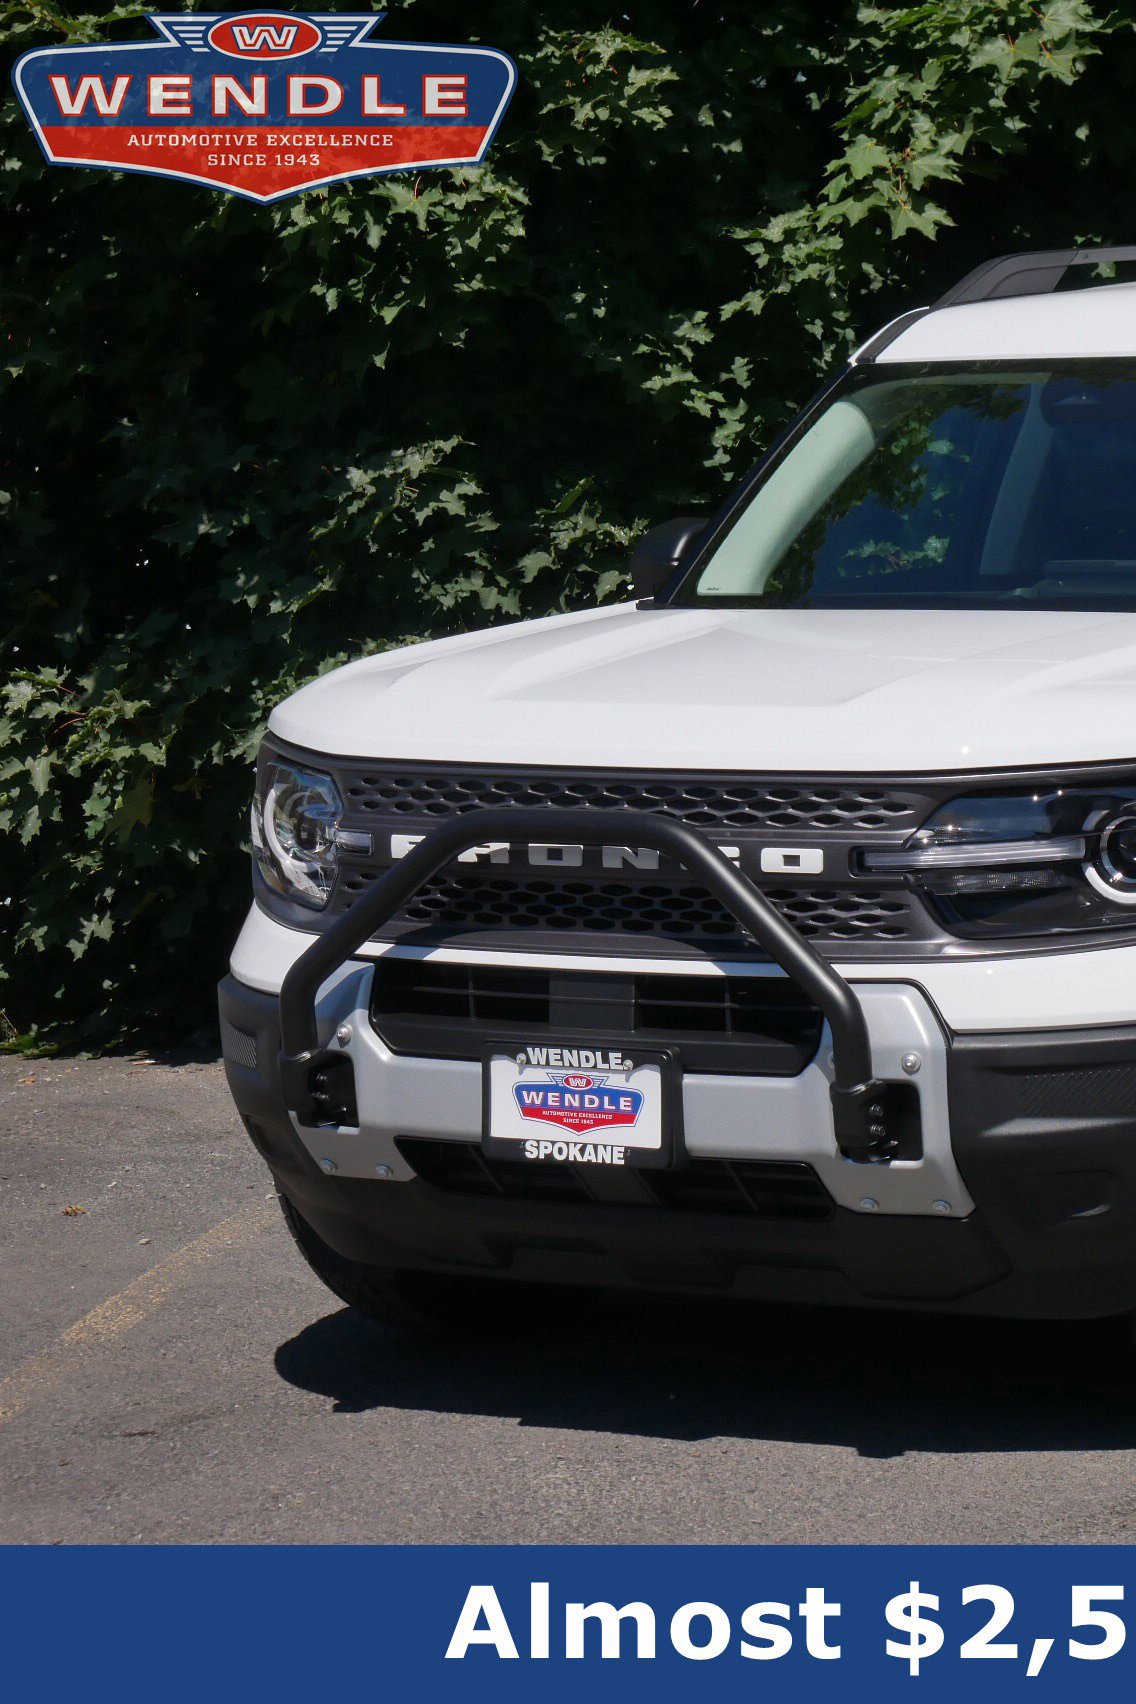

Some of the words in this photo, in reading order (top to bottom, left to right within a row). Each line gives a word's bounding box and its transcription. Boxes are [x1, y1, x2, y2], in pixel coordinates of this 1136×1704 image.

[526, 1047, 623, 1070] WENDLE
[522, 1090, 632, 1110] WENDLE
[525, 1139, 625, 1165] SPOKANE
